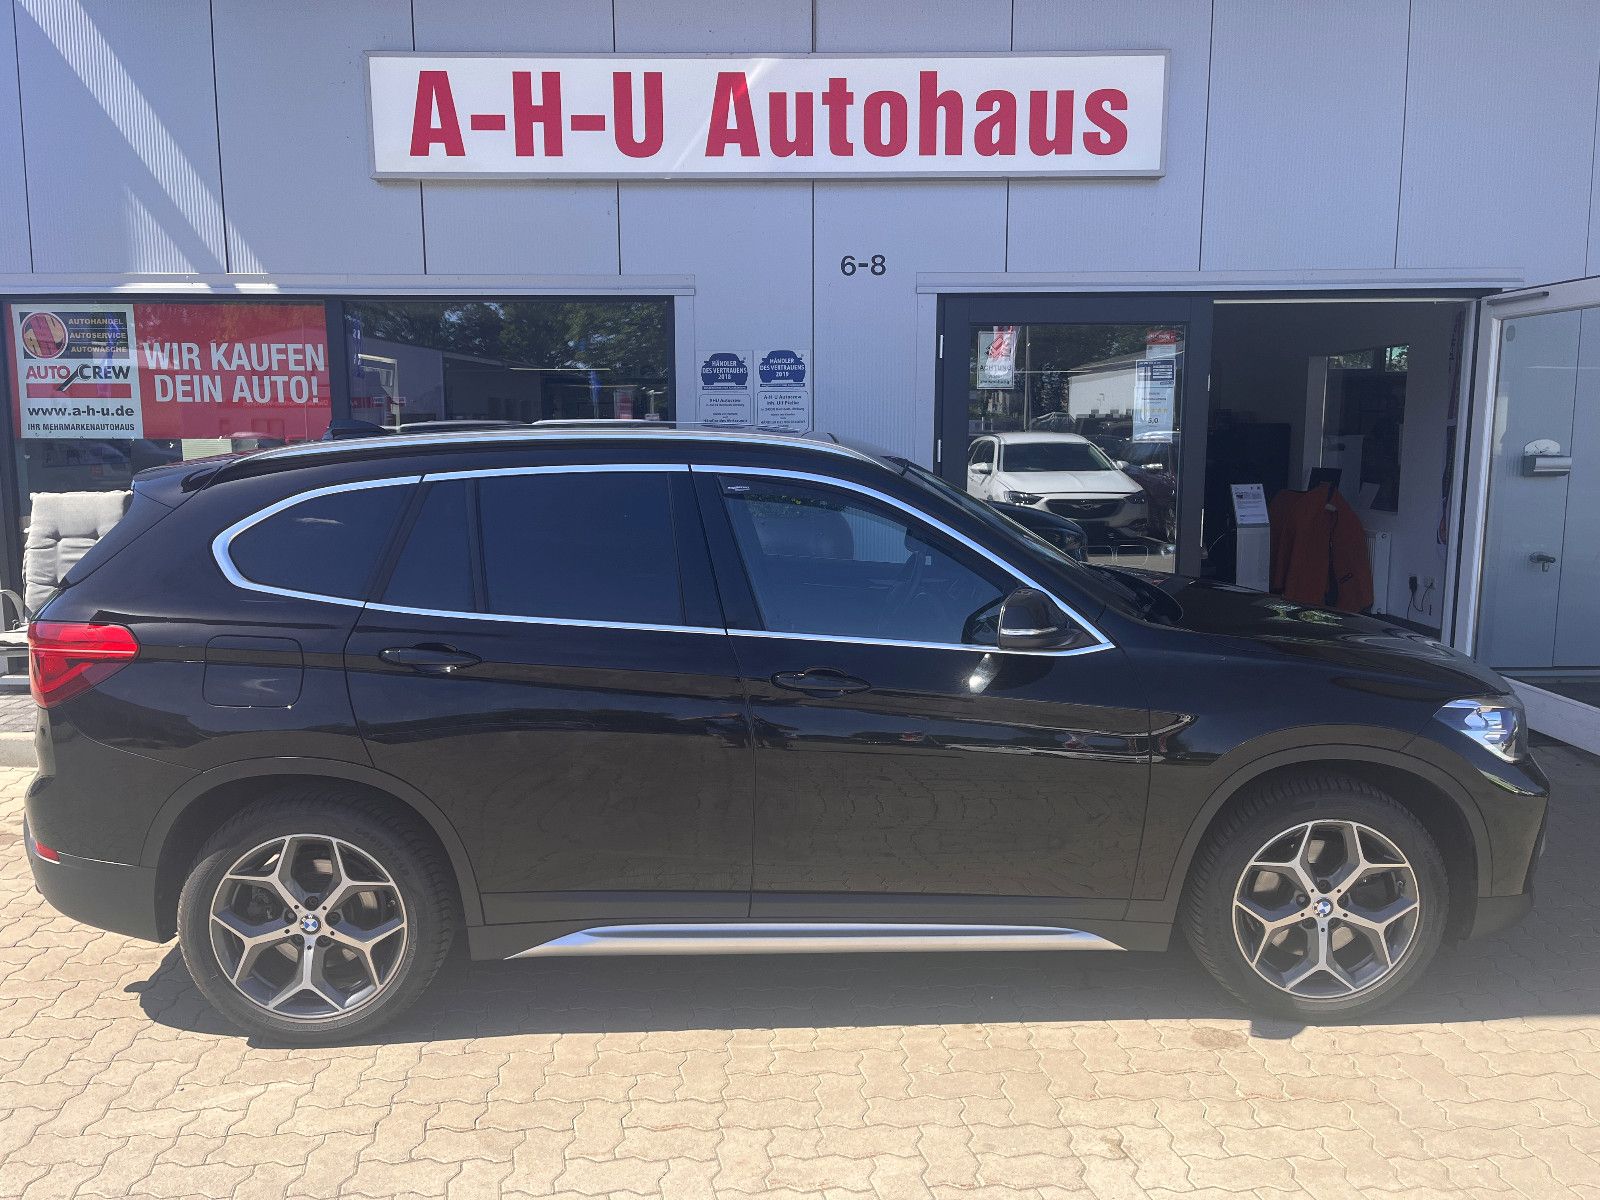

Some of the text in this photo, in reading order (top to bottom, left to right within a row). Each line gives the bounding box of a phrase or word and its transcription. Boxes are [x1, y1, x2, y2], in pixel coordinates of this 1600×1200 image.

[410, 70, 1129, 158] A-H-U Autohaus
[840, 254, 887, 277] 6-8
[142, 342, 326, 373] WIR KAUFEN
[153, 375, 319, 404] DEIN AUTO!
[27, 405, 135, 417] www.a-h-u.de
[27, 423, 135, 431] IHR MEHRMARKENAUTOHAUS
